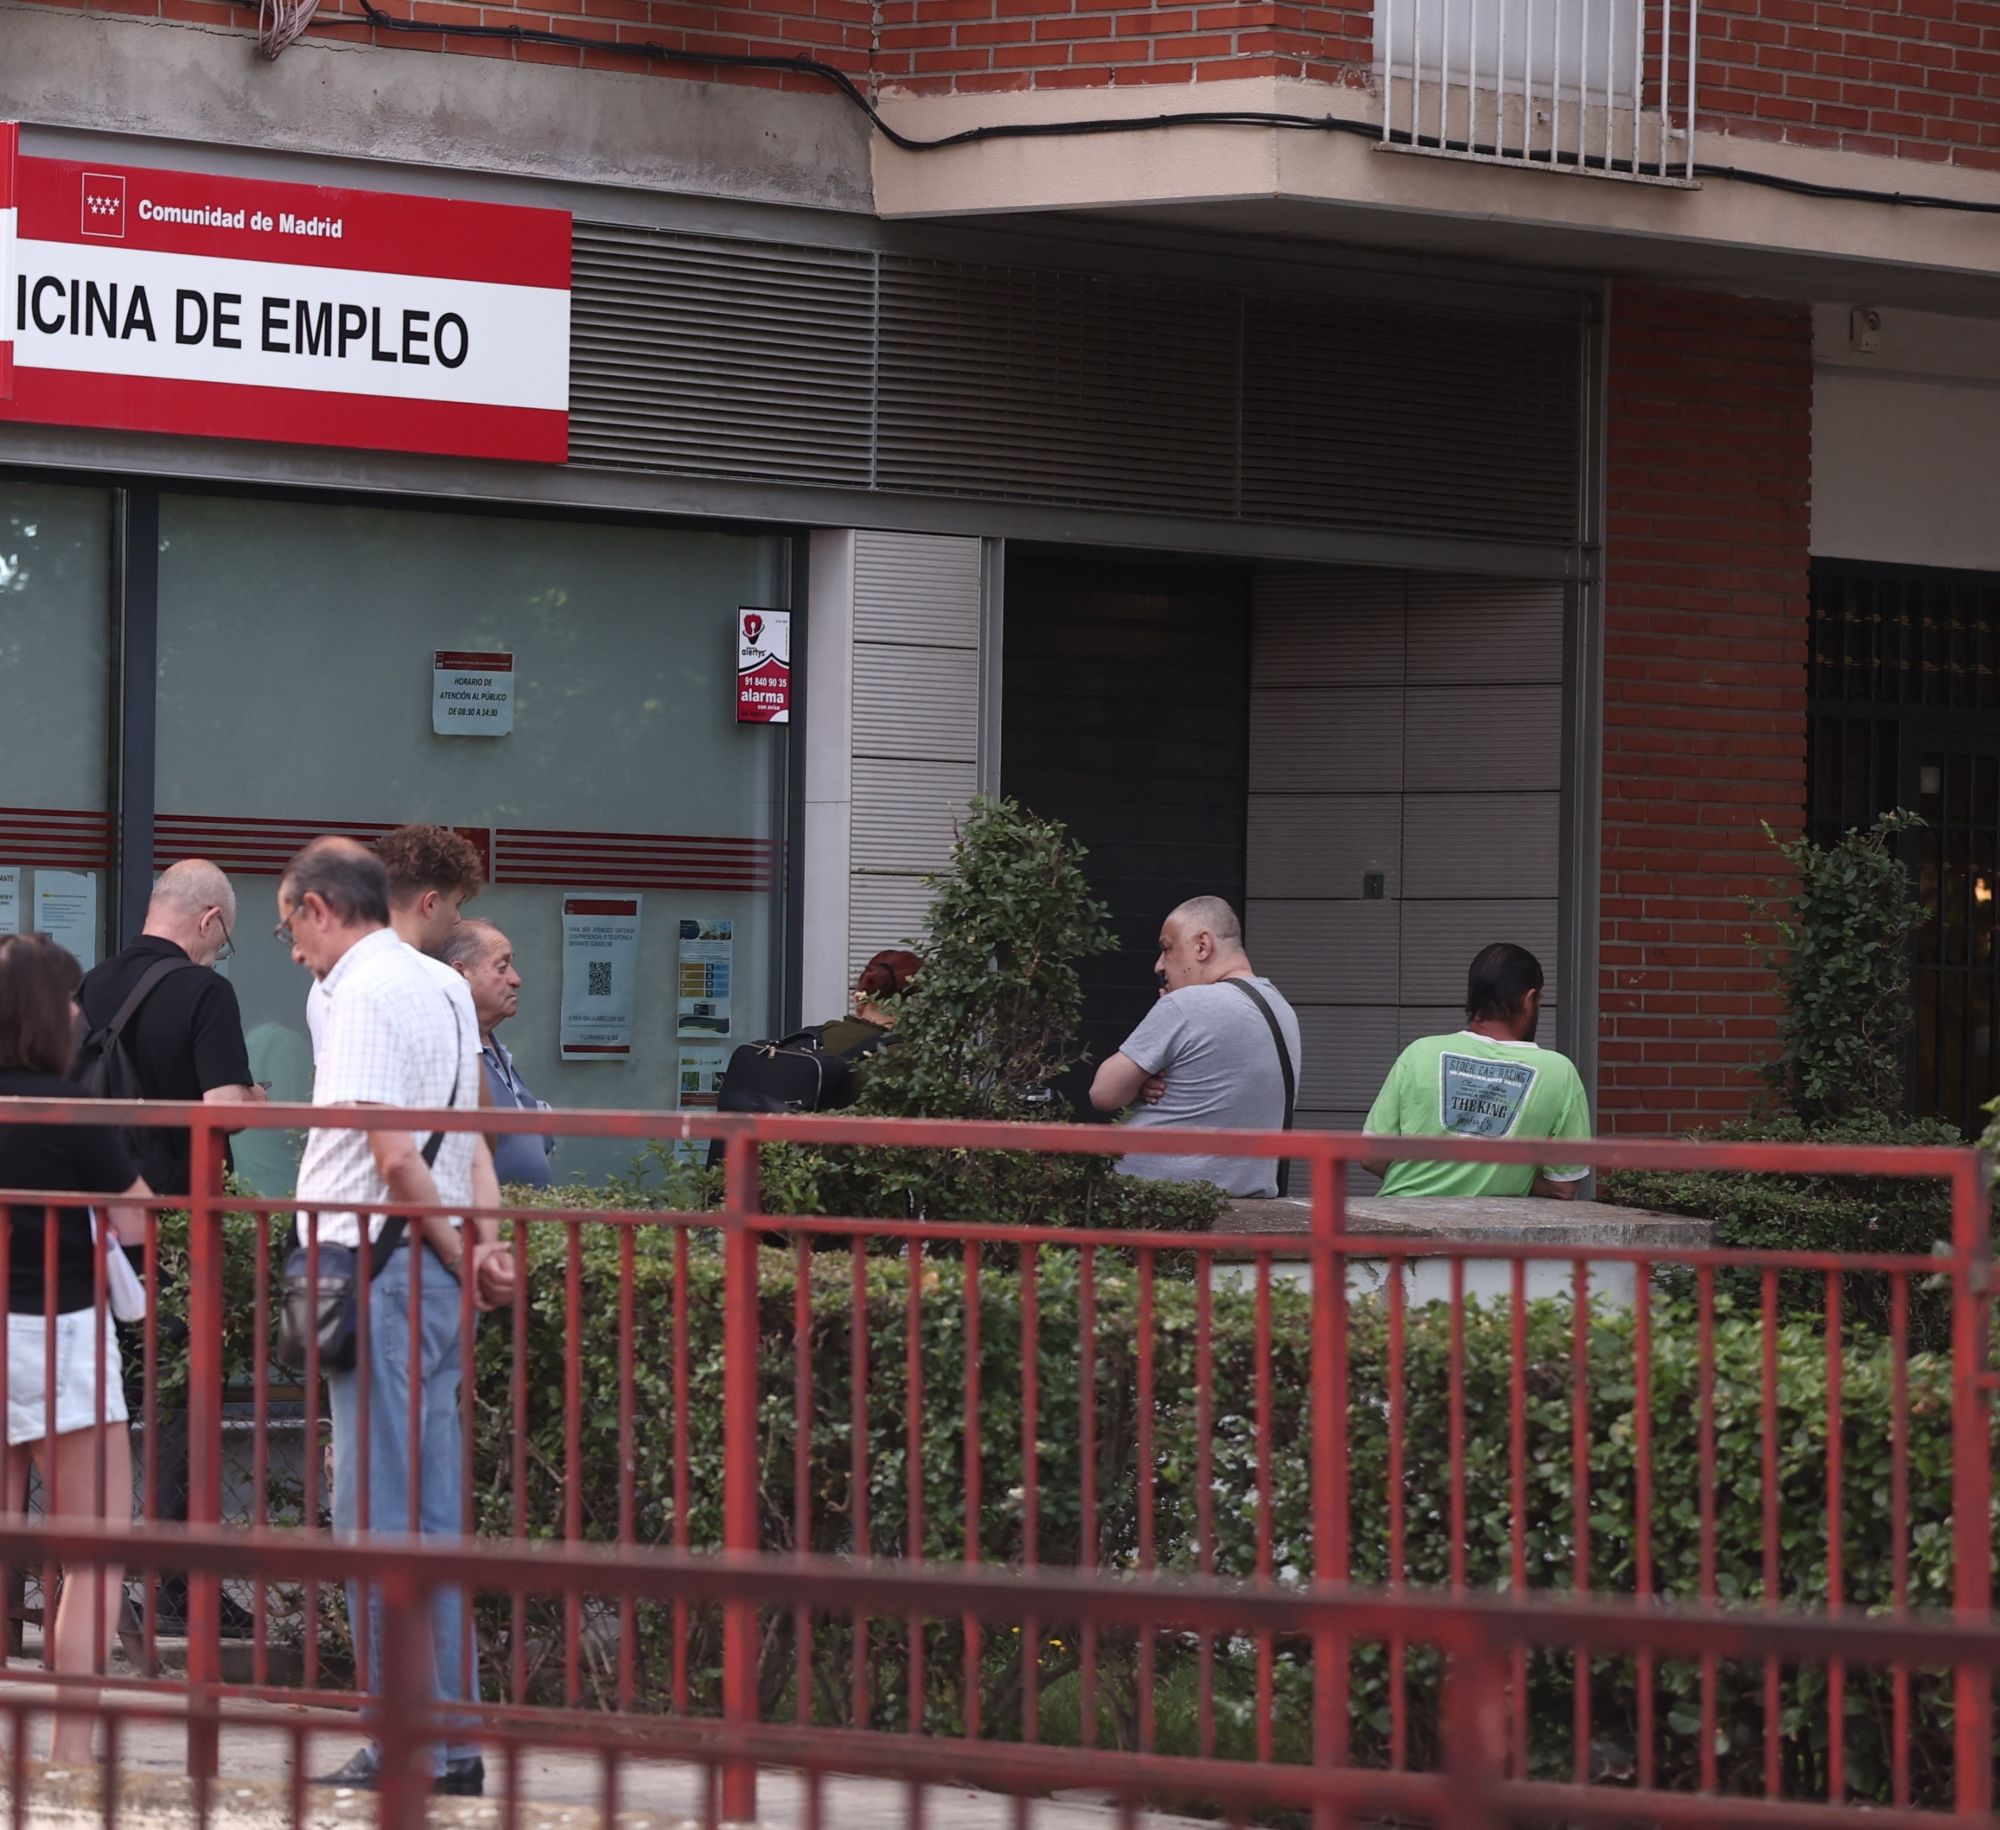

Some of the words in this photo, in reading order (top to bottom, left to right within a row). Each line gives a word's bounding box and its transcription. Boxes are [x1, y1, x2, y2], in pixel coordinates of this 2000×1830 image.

[138, 199, 245, 230] Comunidad
[249, 211, 274, 232] de
[278, 213, 343, 239] Madrid
[175, 288, 243, 350] DE
[261, 296, 469, 370] EMPLEO
[454, 677, 483, 687] HORARIO
[484, 678, 494, 687] DE
[744, 676, 753, 686] 91
[754, 677, 768, 687] 840
[768, 678, 777, 688] 90
[778, 678, 788, 688] 35
[439, 690, 471, 701] ATENCIÓN
[471, 692, 480, 701] AL
[481, 691, 508, 702] PÚBLICO
[740, 687, 785, 704] alarma
[448, 707, 458, 716] DE
[475, 708, 481, 717] A
[1478, 1065, 1496, 1078] CAR
[1498, 1067, 1527, 1084] RACING
